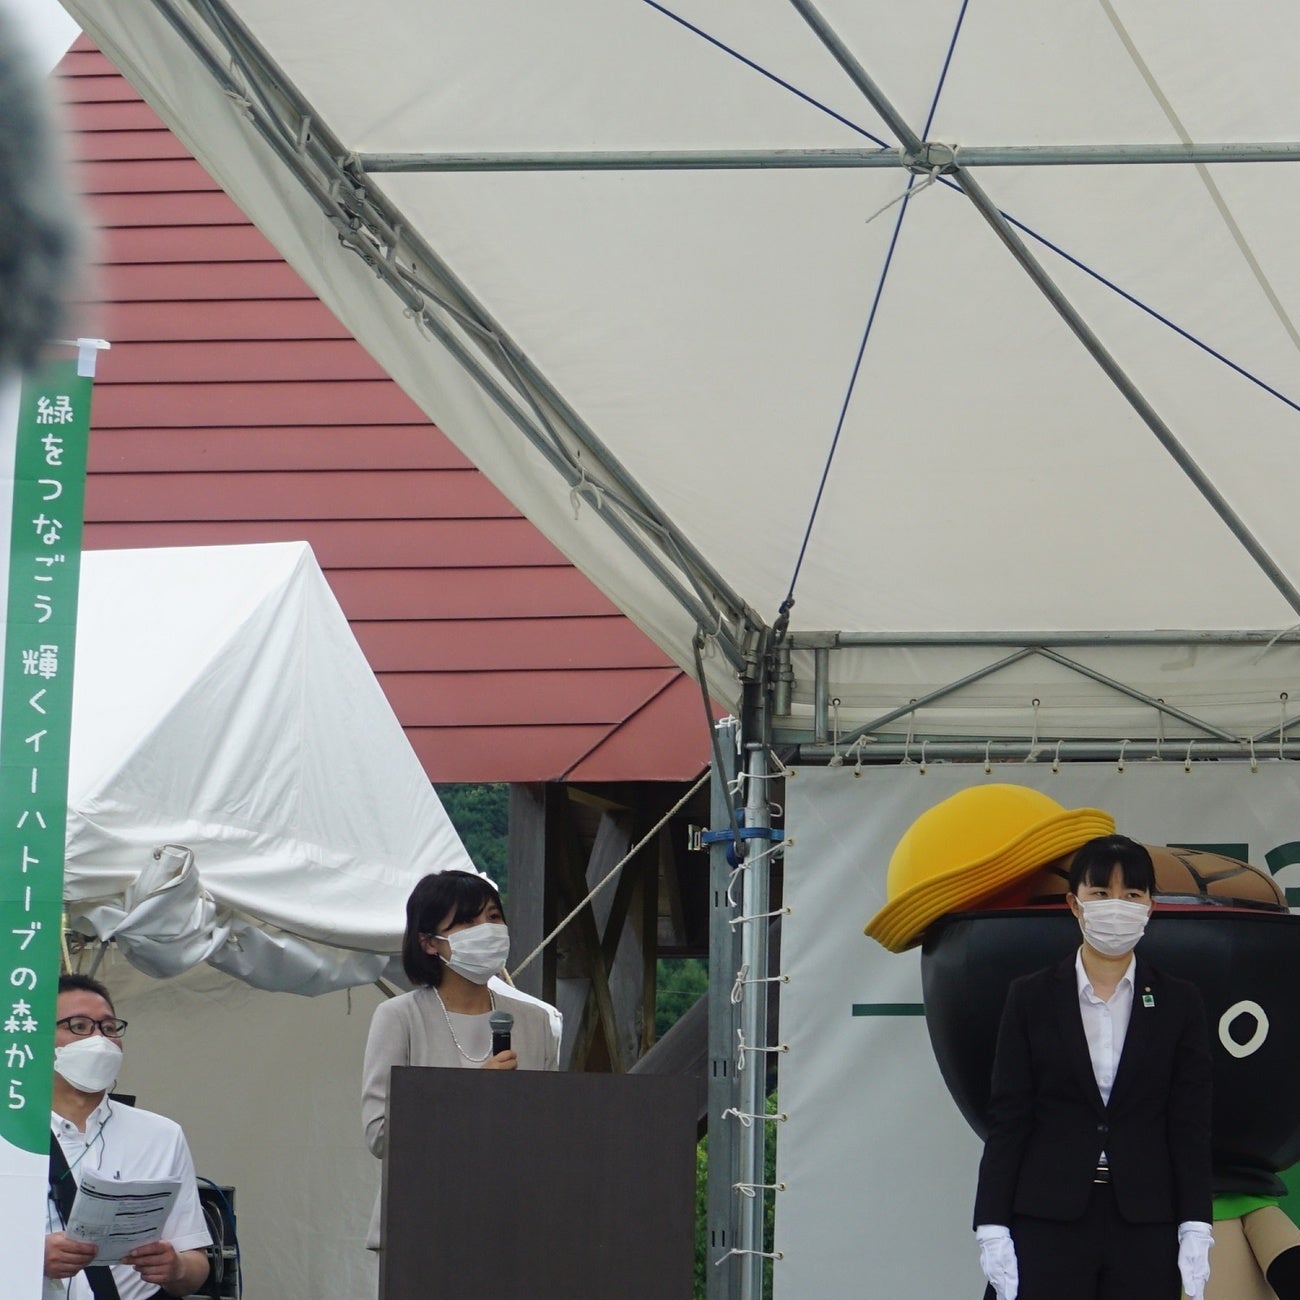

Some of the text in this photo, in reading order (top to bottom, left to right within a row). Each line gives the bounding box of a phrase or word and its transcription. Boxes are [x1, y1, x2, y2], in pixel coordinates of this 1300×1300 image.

[4, 395, 74, 1110] 緑をつなごう 輝くイーハトーブの森から
